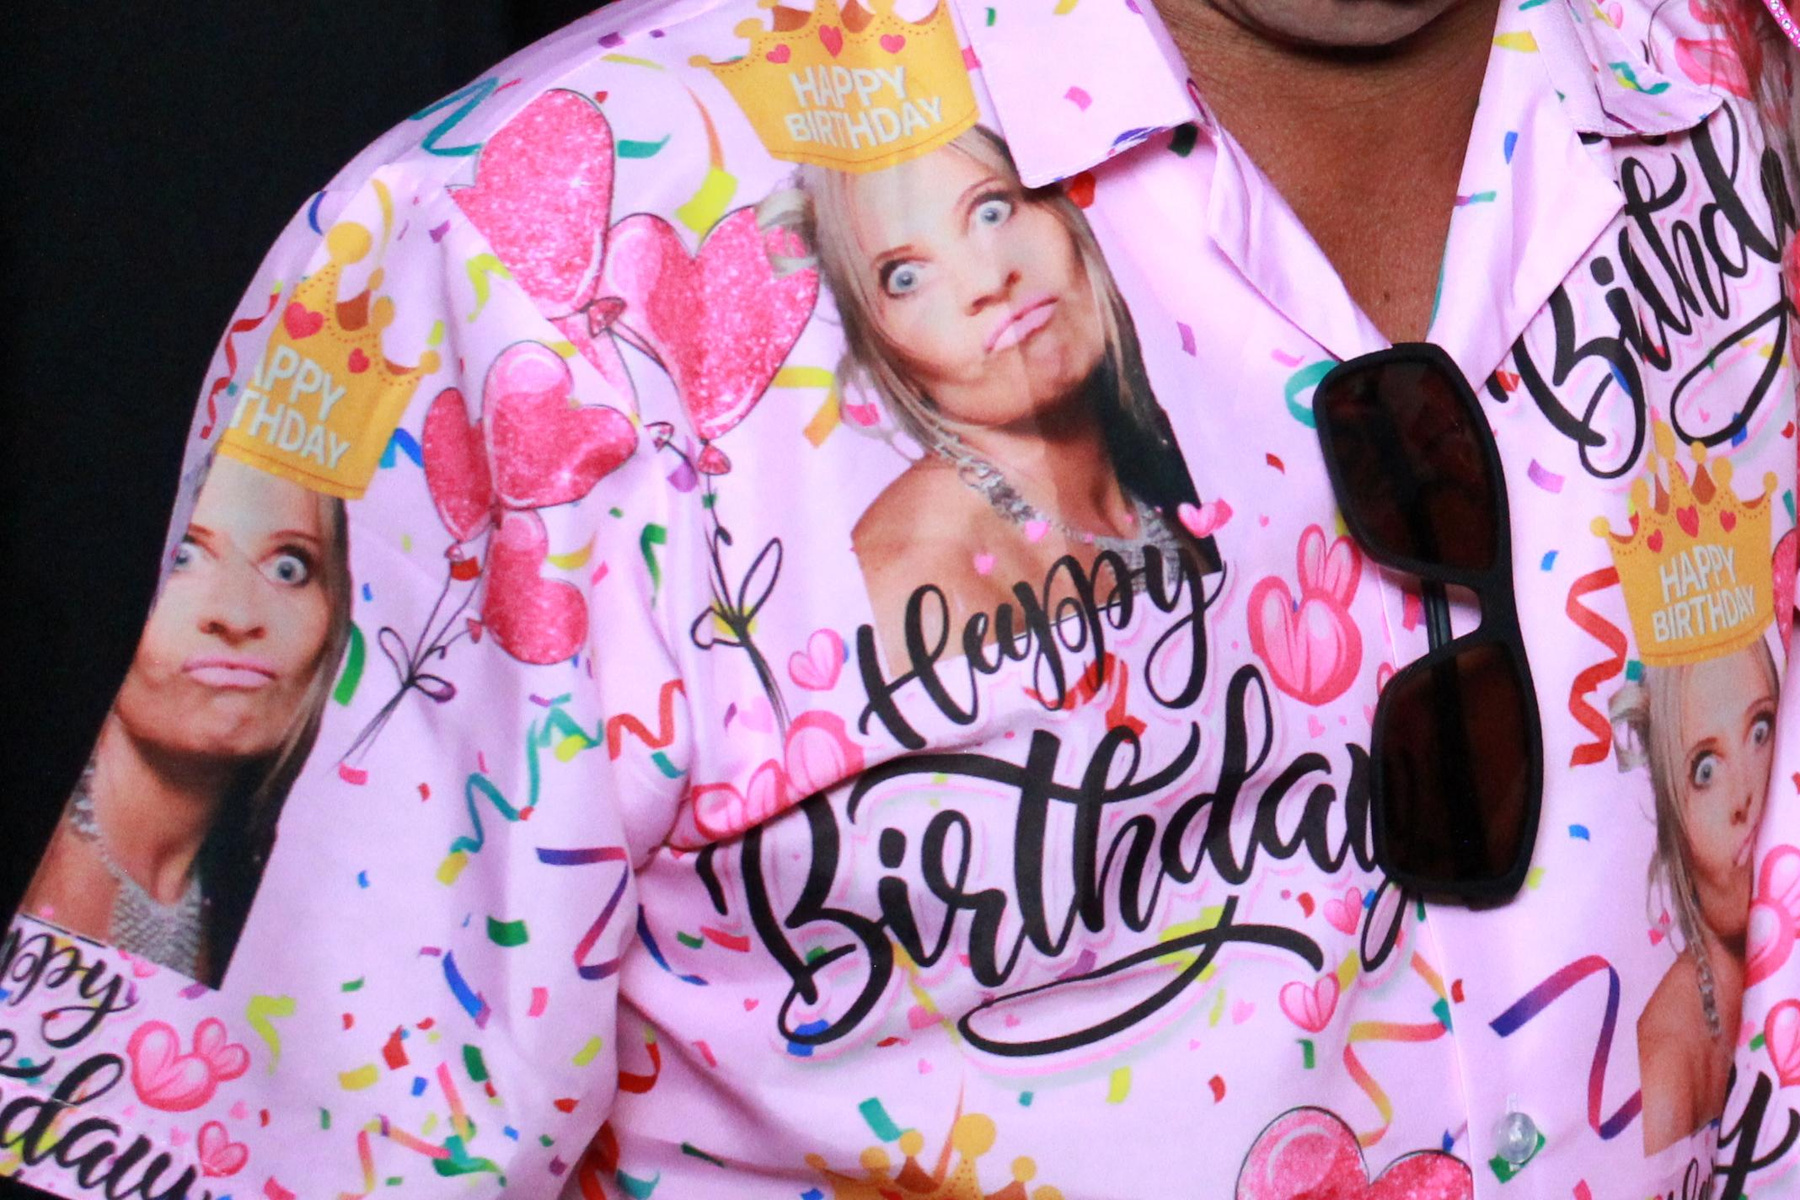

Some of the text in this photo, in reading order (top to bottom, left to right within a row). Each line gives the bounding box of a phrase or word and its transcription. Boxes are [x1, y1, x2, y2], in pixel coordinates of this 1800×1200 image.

[789, 64, 907, 108] HAPPY
[785, 96, 943, 149] BIRTHDAY
[254, 345, 347, 422] PPY
[229, 389, 350, 469] THDAY
[1659, 544, 1738, 604] HAPPY
[1652, 584, 1756, 643] BIRTHDAY
[857, 545, 1227, 750] Happy
